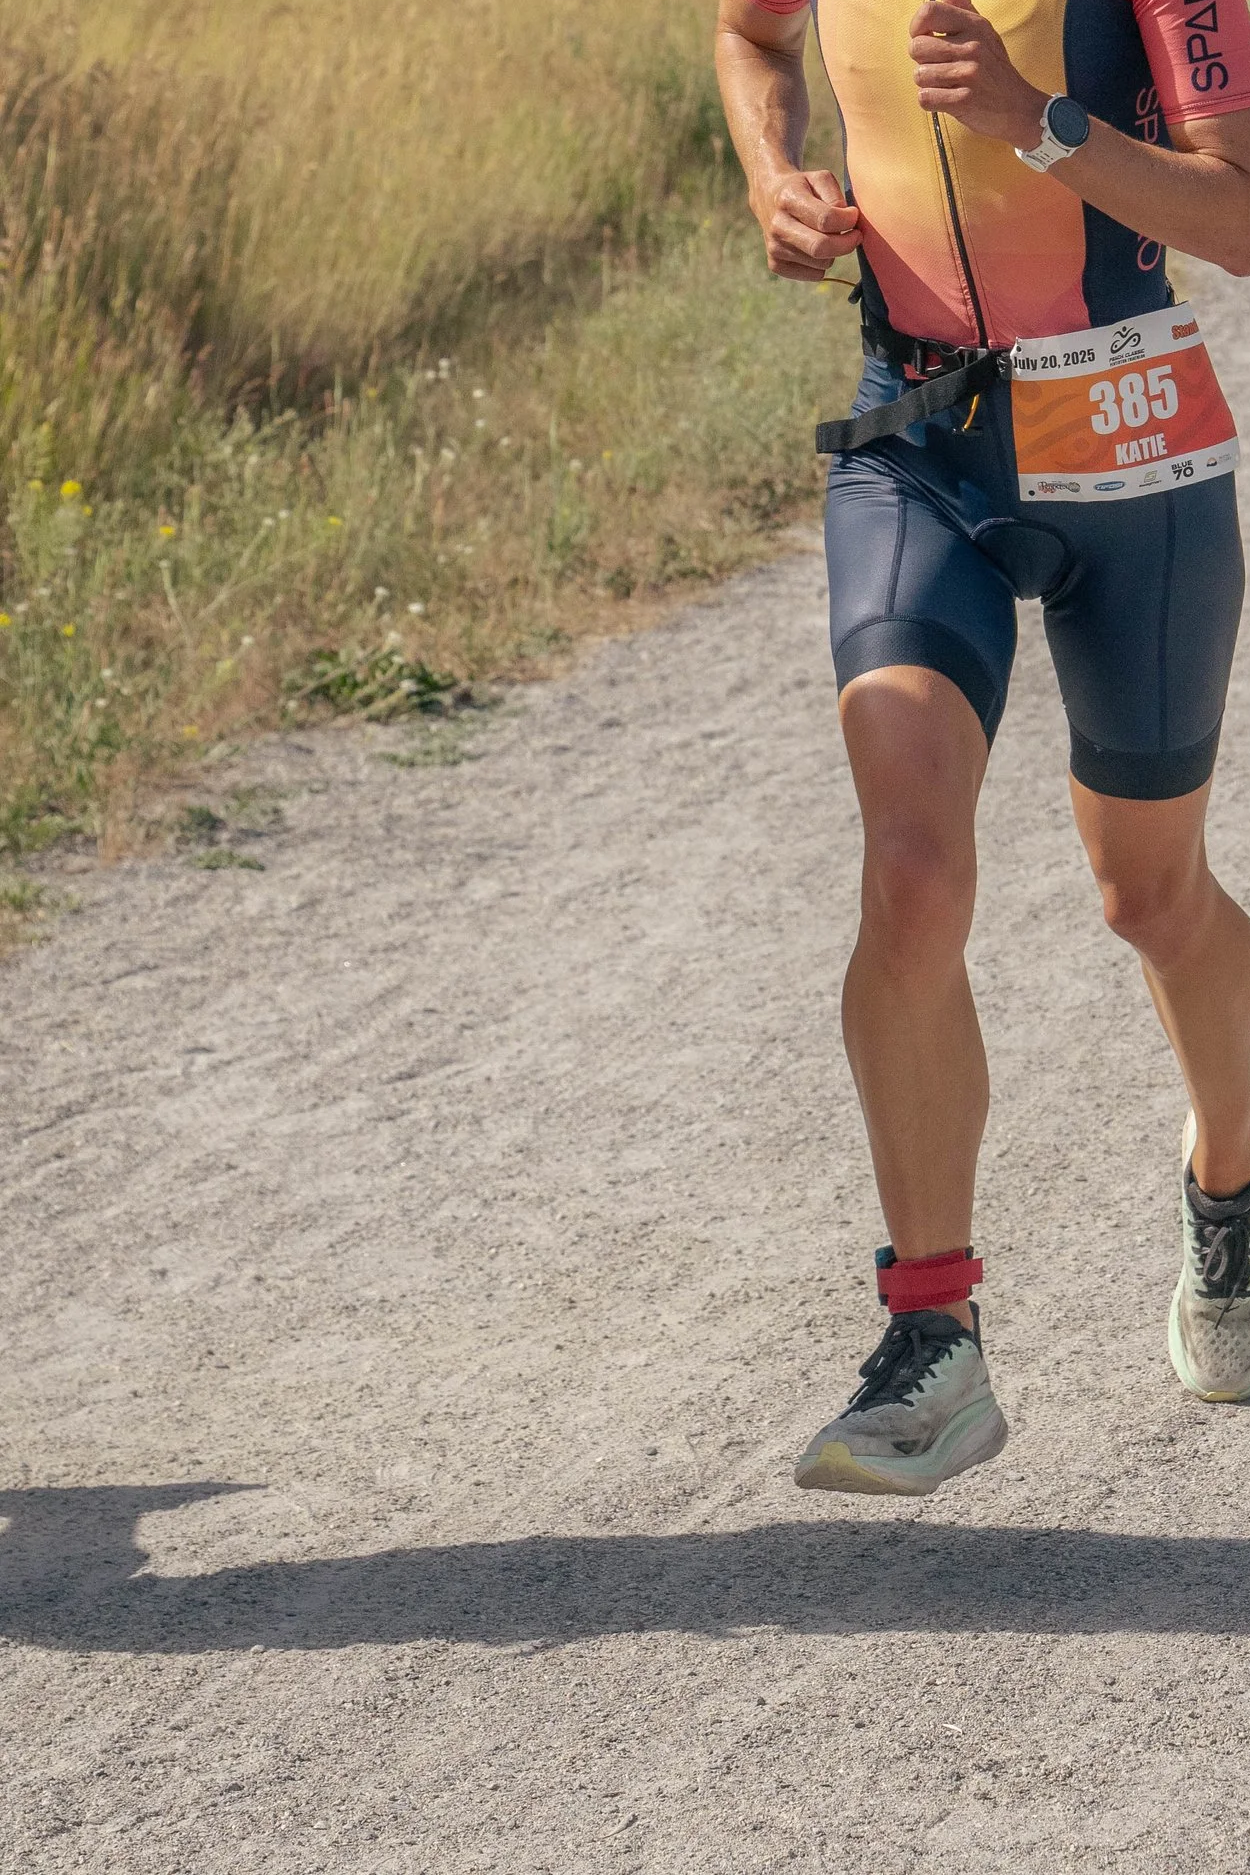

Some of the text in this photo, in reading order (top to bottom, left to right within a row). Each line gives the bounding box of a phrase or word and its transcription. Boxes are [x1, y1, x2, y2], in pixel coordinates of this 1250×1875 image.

[1013, 348, 1096, 371] July 20, 2025
[1089, 365, 1179, 435] 385
[1115, 433, 1168, 465] KATIE
[1171, 459, 1193, 471] BLUE
[1172, 466, 1194, 481] 70
